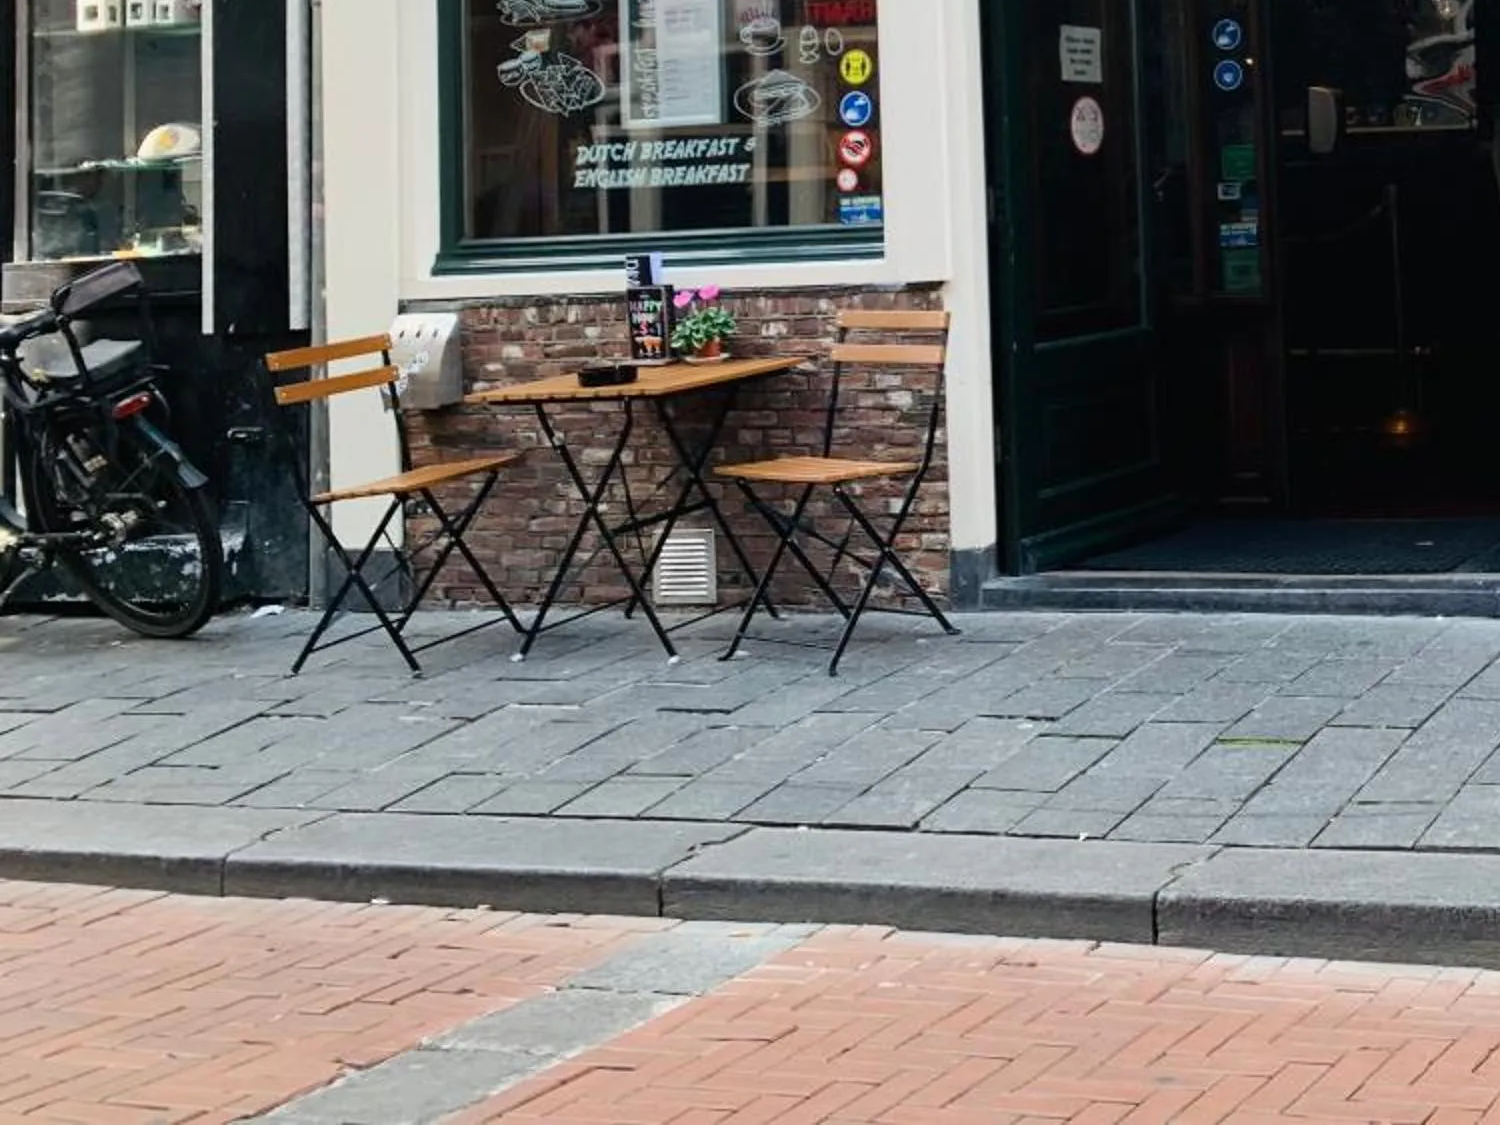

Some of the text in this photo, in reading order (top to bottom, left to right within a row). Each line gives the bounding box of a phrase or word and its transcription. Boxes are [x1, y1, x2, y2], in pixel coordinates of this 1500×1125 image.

[576, 141, 636, 165] DUTCH
[640, 137, 740, 161] BREAKFAST
[574, 164, 751, 189] ENGLISH BREAKFAST
